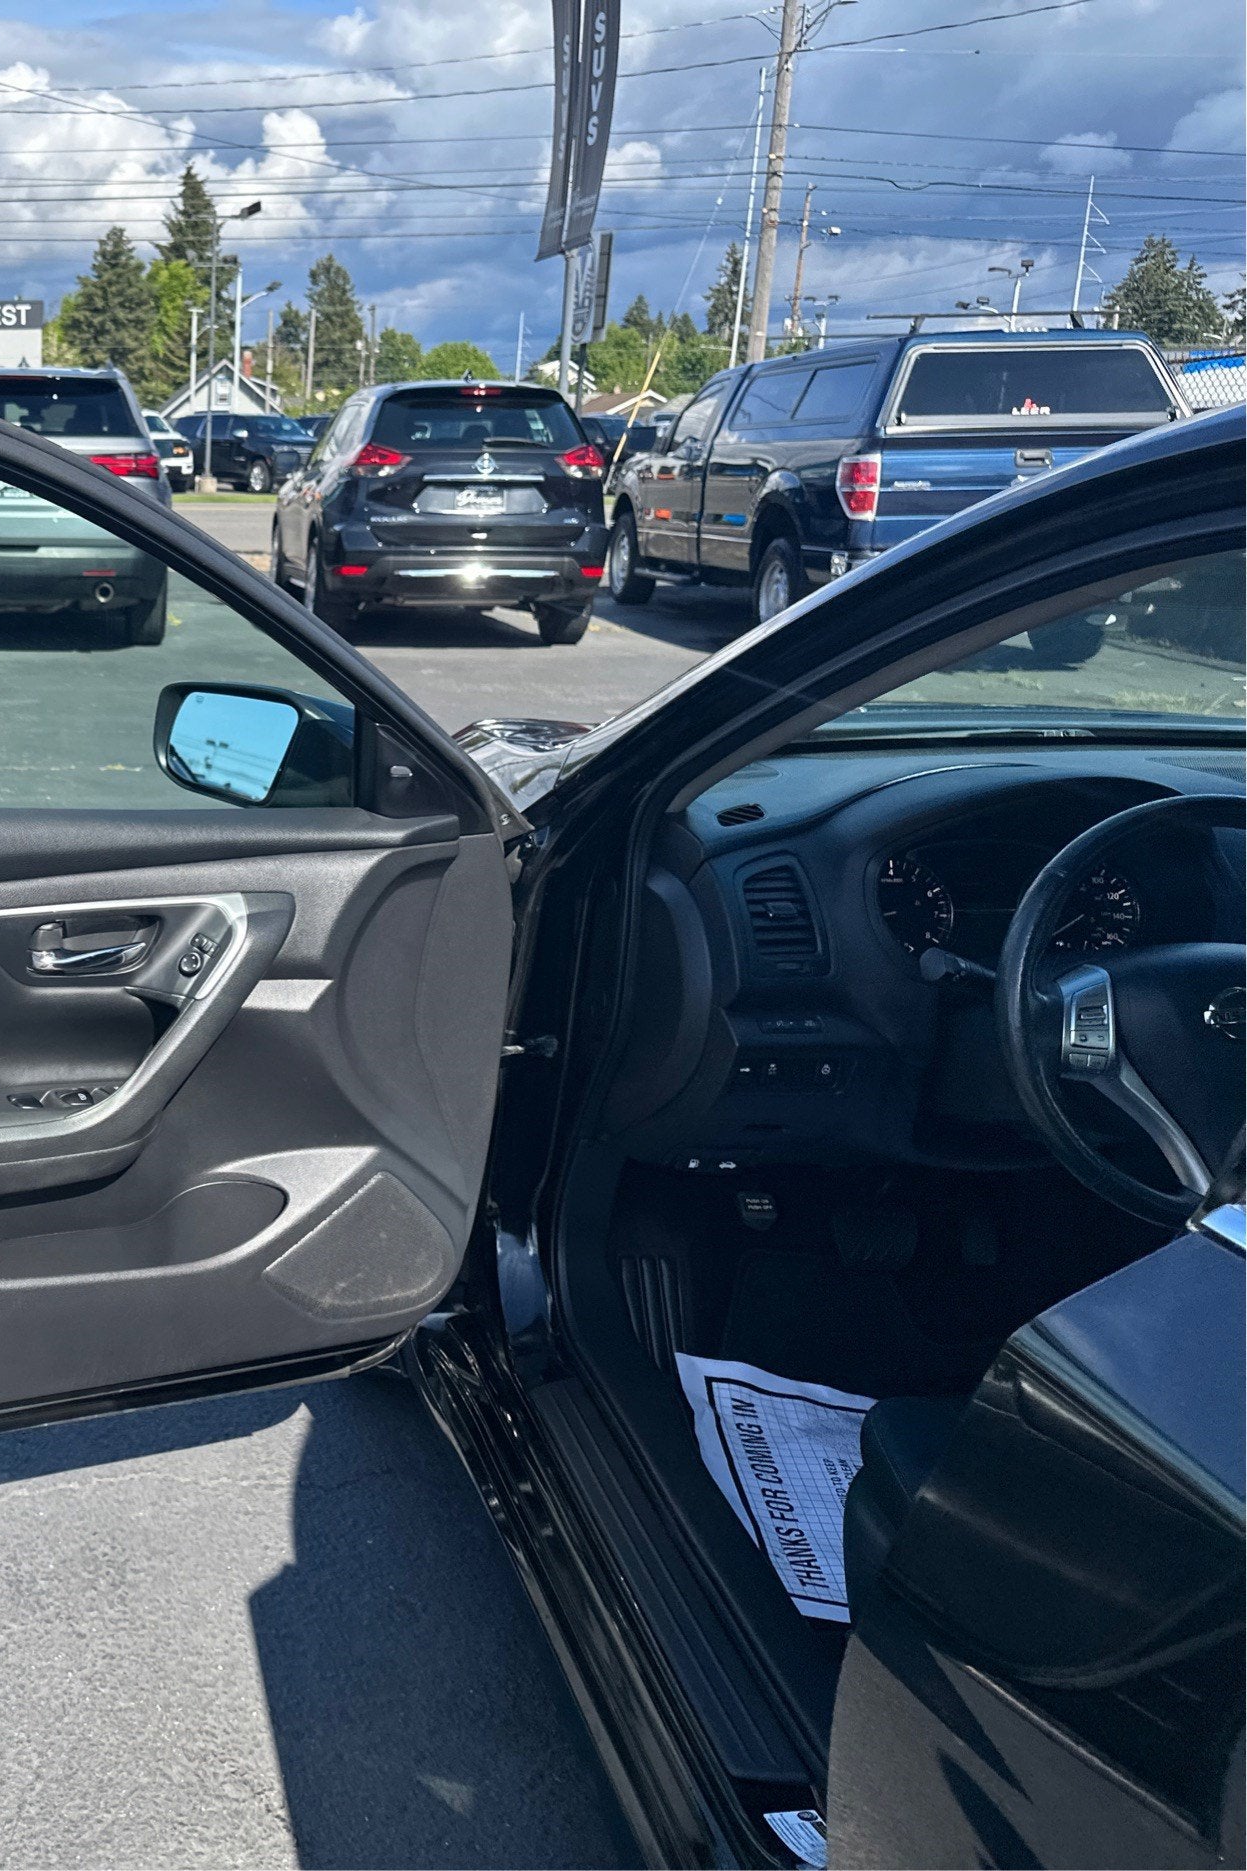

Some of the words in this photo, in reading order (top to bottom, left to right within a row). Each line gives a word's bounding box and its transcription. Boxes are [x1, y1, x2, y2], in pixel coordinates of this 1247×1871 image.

[587, 11, 606, 146] SUVS
[731, 1397, 759, 1419] IN
[735, 1422, 784, 1486] COMING
[822, 1458, 839, 1476] KEEP
[761, 1487, 799, 1523] FOR
[775, 1526, 830, 1589] THANKS
